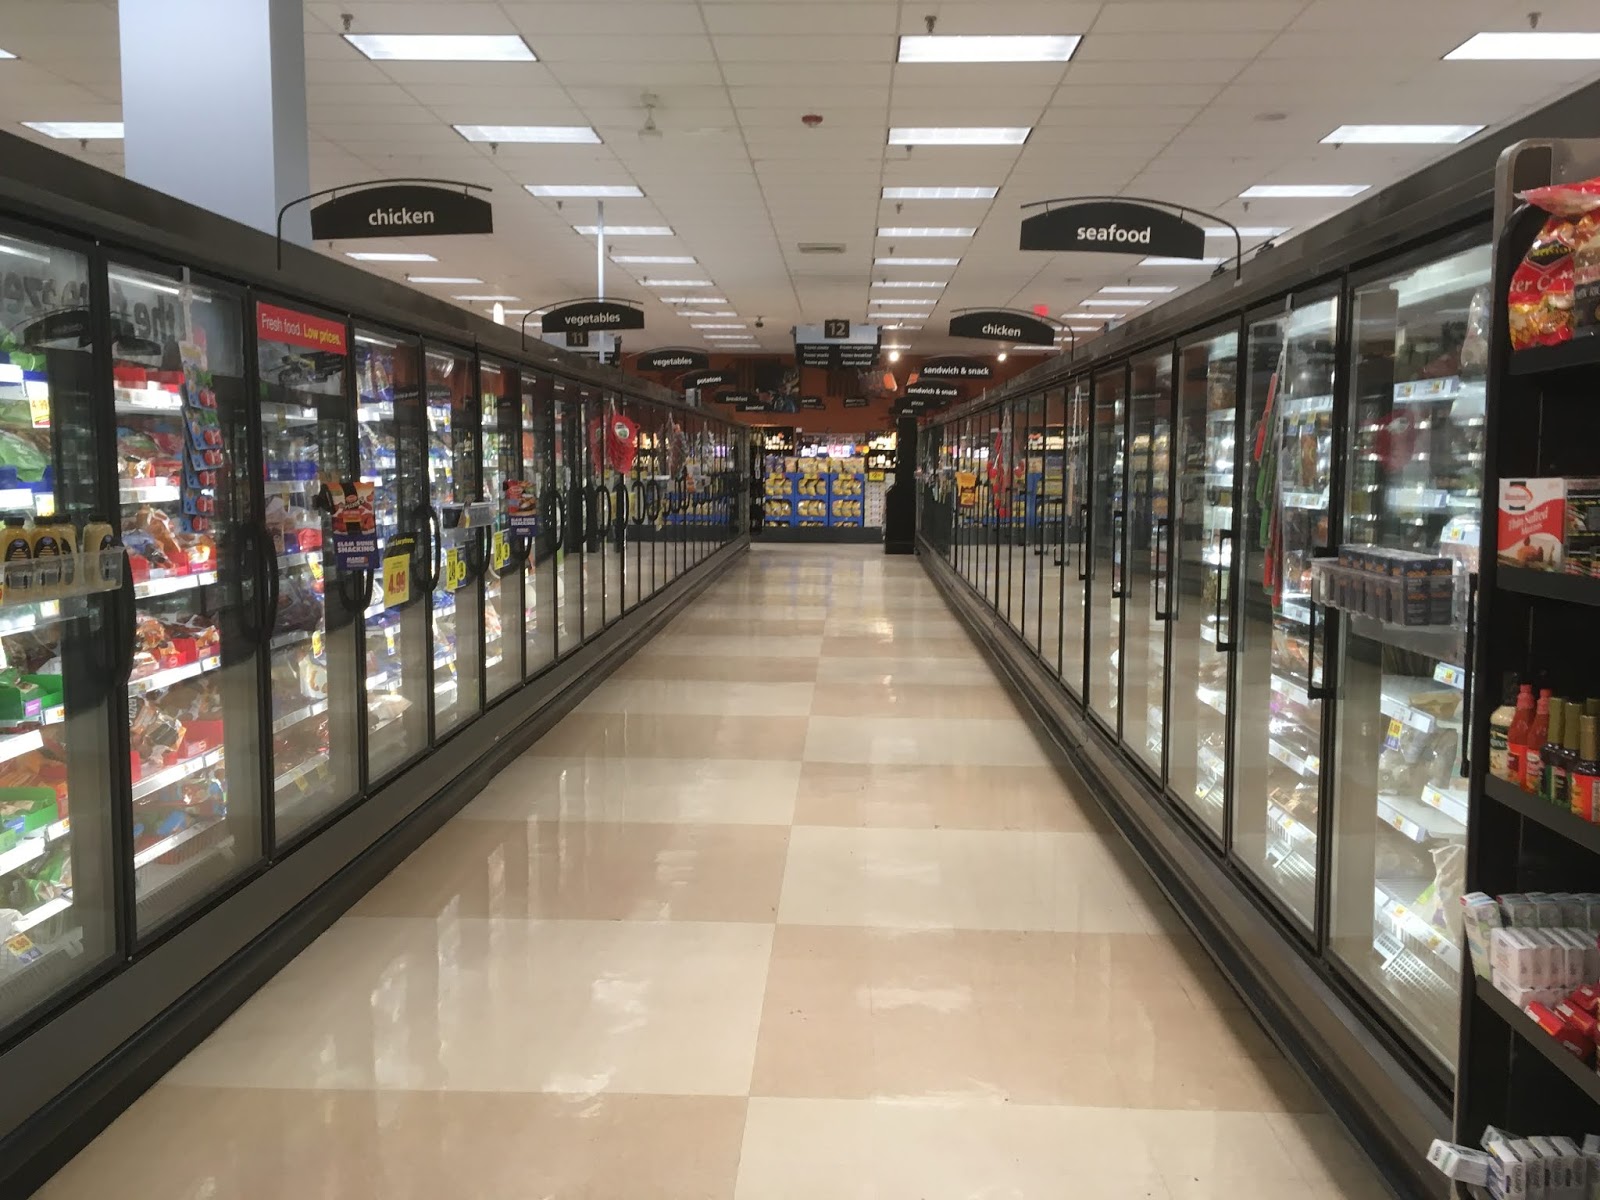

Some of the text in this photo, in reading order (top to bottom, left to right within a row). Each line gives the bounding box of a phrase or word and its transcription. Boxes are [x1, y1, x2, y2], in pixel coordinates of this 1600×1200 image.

[368, 207, 435, 226] chicken
[1077, 223, 1151, 244] seafood
[565, 312, 620, 326] vegetables
[261, 313, 283, 333] Fresh
[303, 323, 318, 340] Low
[319, 329, 342, 346] prices.
[829, 322, 846, 336] 12
[981, 323, 1021, 338] chicken
[571, 332, 583, 344] 11
[653, 356, 692, 367] vegetables
[924, 366, 959, 374] sandwich
[968, 367, 989, 375] snack
